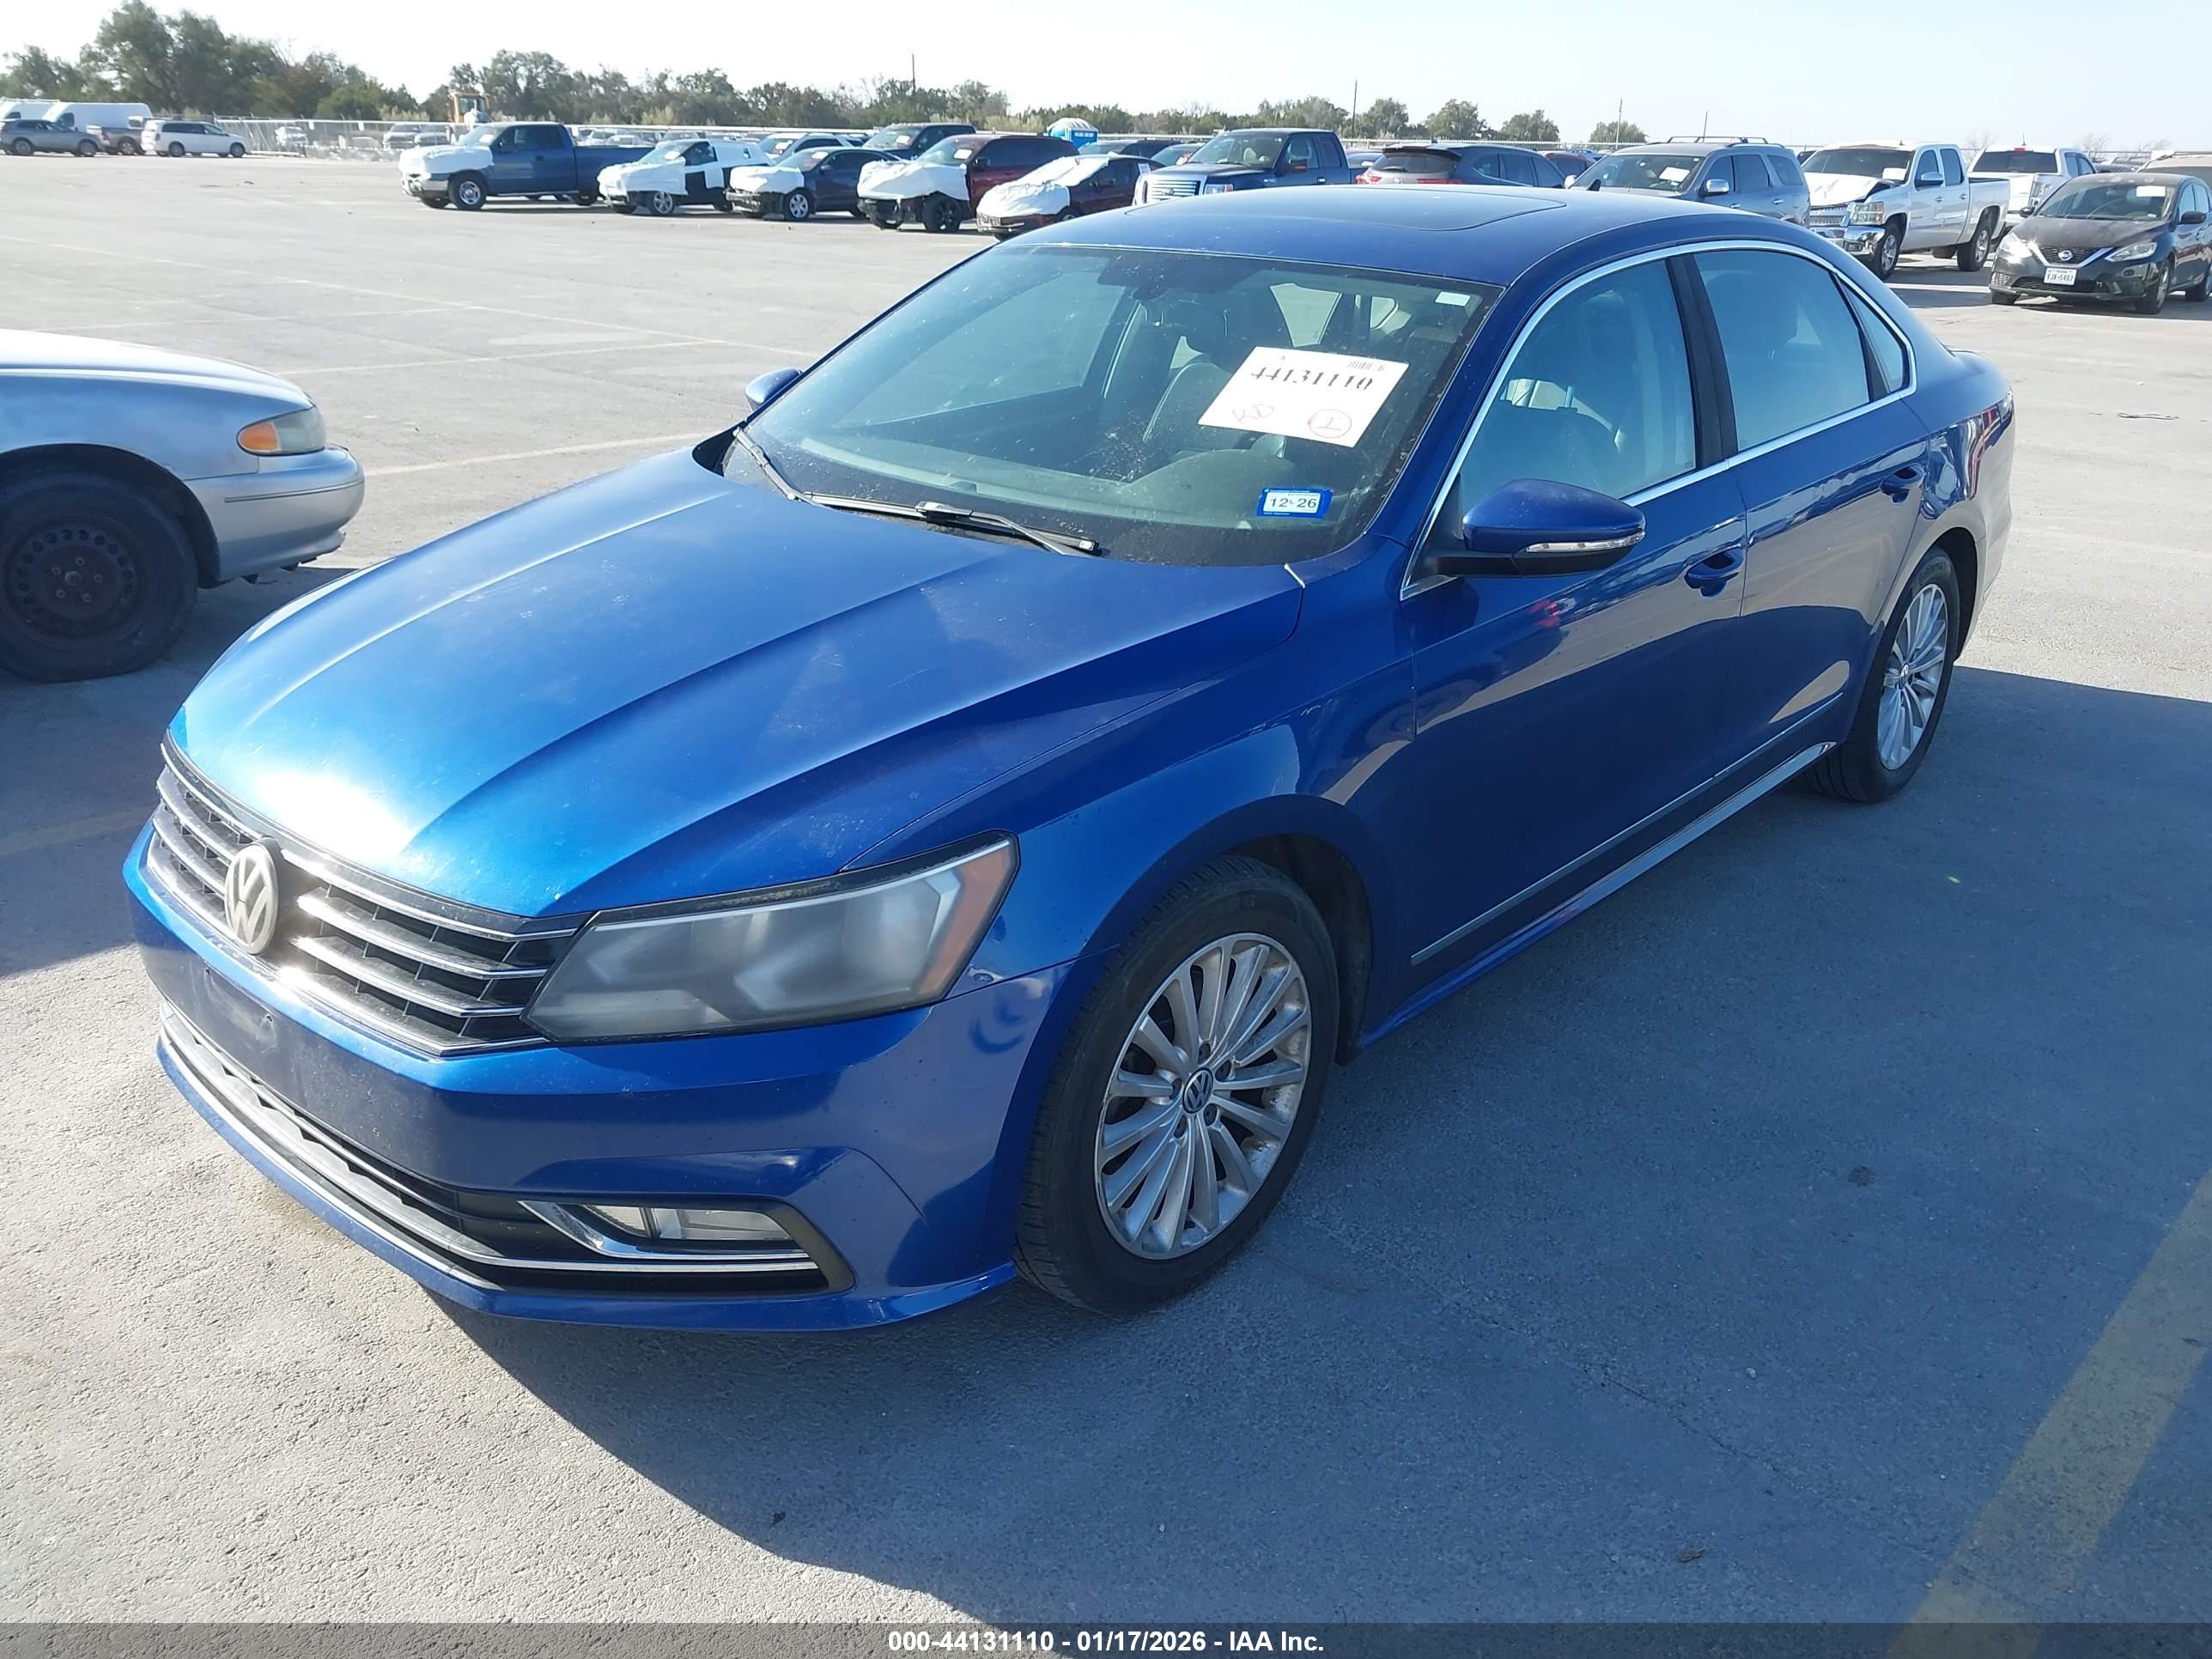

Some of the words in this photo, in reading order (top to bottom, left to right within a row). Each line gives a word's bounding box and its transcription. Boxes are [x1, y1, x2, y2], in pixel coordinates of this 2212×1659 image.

[1251, 366, 1373, 391] 44131110
[1270, 497, 1289, 507] 12
[1297, 498, 1318, 508] 26
